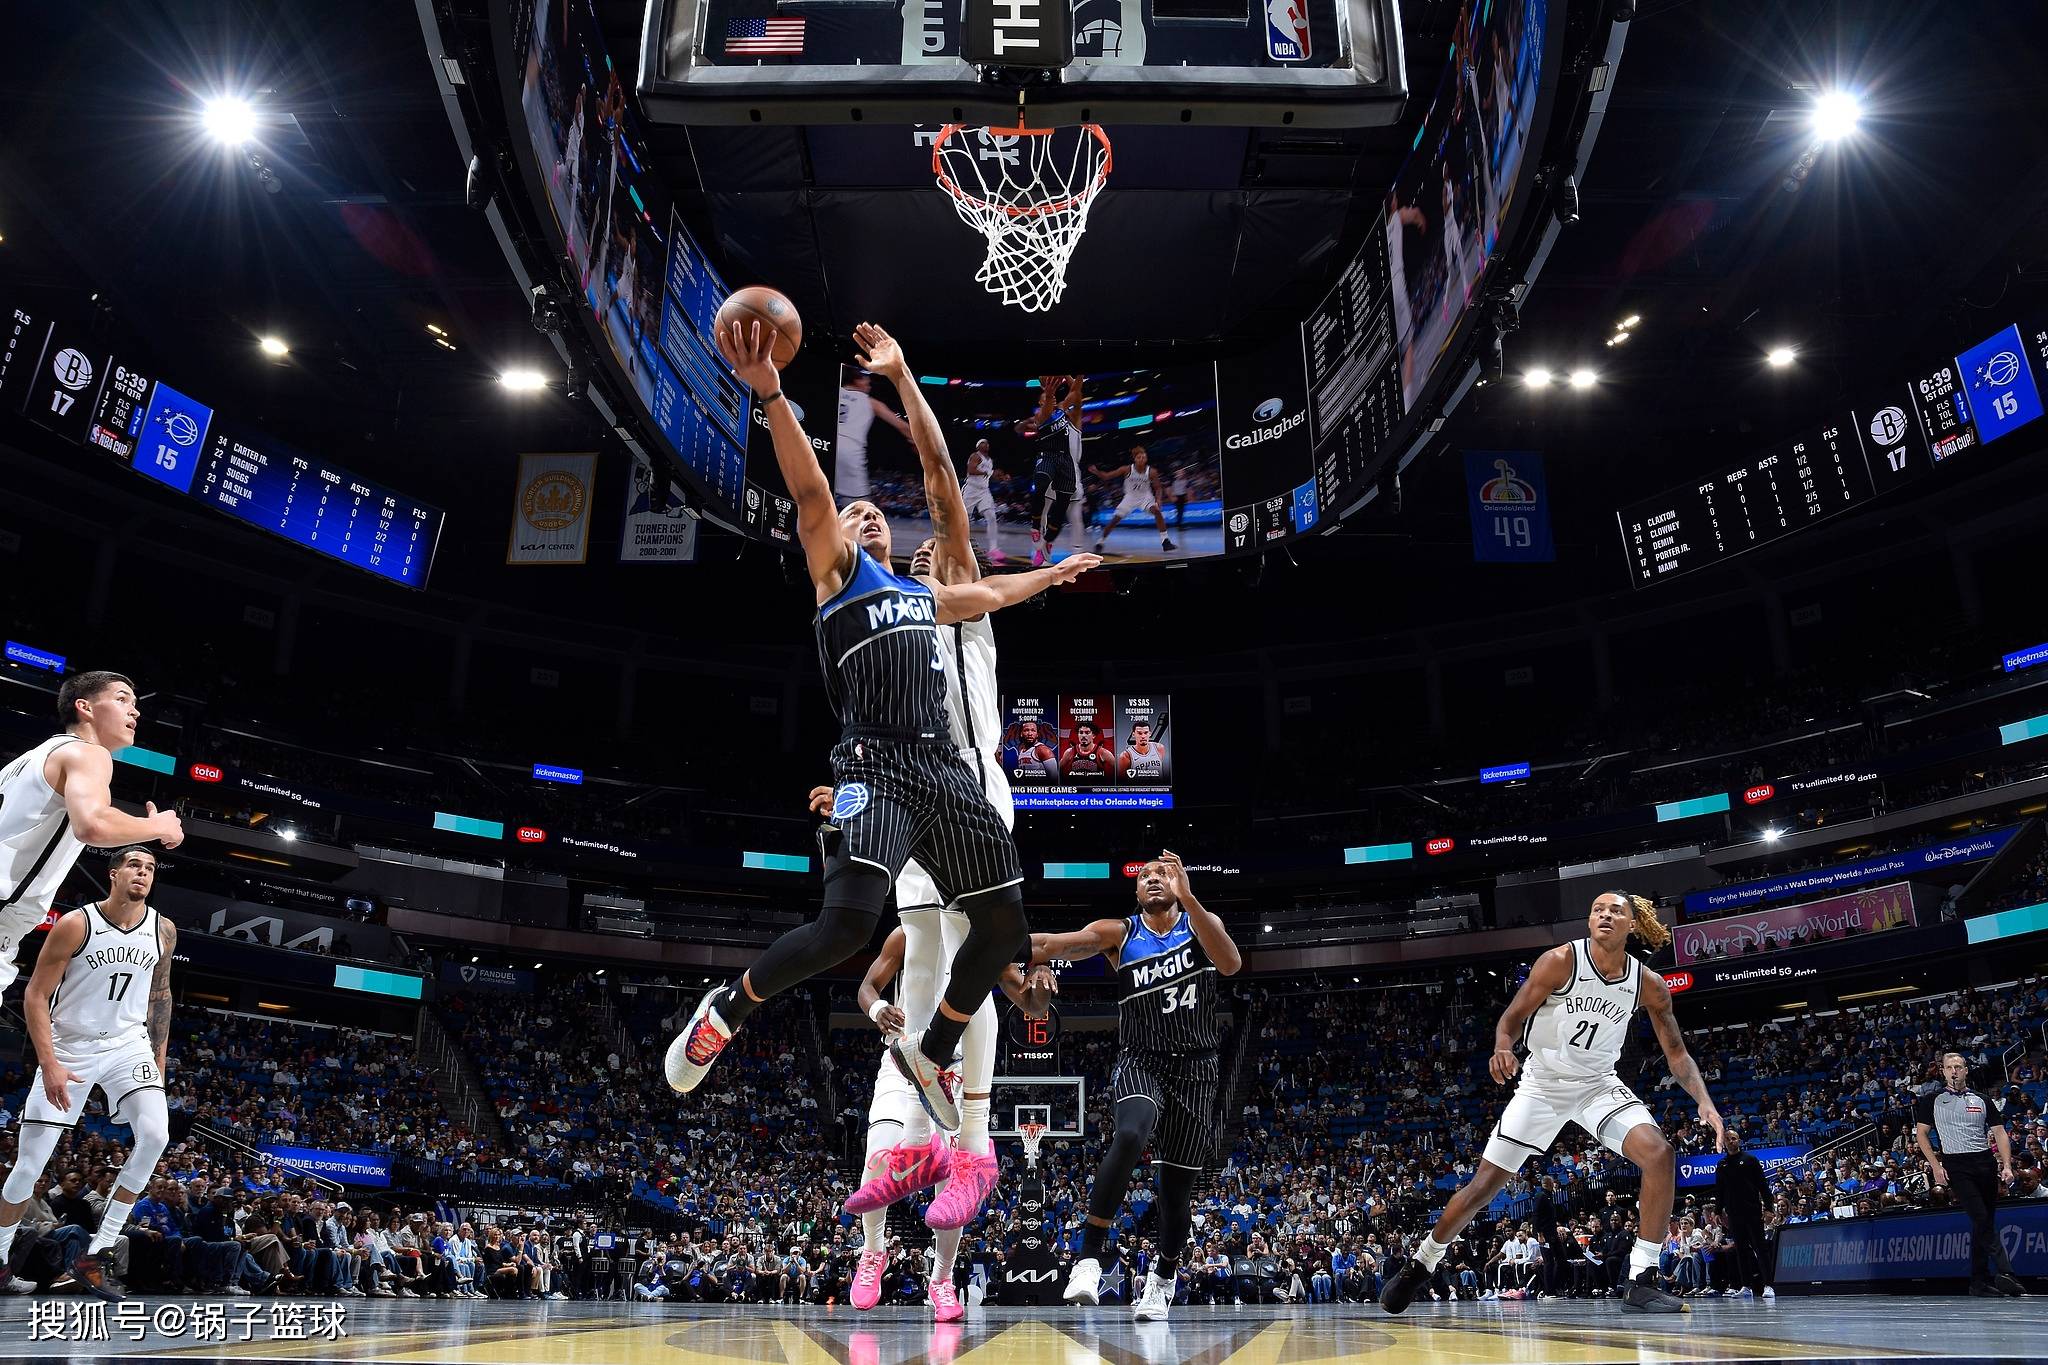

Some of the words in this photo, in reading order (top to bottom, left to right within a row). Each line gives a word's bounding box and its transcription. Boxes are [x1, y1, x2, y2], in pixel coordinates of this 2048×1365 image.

[1275, 43, 1295, 55] NBA
[14, 309, 31, 325] FLS
[116, 366, 147, 392] 6:39
[1920, 368, 1951, 394] 6:39
[115, 381, 127, 392] 1ST
[127, 388, 141, 400] QTR
[1925, 391, 1937, 402] 1ST
[1938, 383, 1953, 396] QTR
[51, 390, 74, 416] 17
[118, 399, 130, 410] FLS
[1936, 400, 1950, 411] FLS
[1993, 391, 2018, 420] 15
[112, 417, 124, 428] CHL
[115, 407, 126, 419] TOL
[1939, 410, 1952, 421] TOL
[1226, 409, 1306, 450] Gallagher
[1942, 418, 1956, 430] CHL
[99, 434, 113, 450] NBA
[113, 440, 128, 456] CUP
[218, 436, 228, 446] 34
[234, 443, 258, 461] CARTER
[258, 455, 268, 466] JR.
[1942, 442, 1957, 458] NBA
[1956, 434, 1971, 451] CUP
[154, 444, 178, 470] 15
[214, 448, 224, 458] 22
[230, 455, 258, 475] WAGNER
[1699, 483, 1714, 494] PTS
[1727, 469, 1748, 483] REBS
[1758, 456, 1778, 470] ASTS
[1794, 444, 1805, 454] FG
[1823, 428, 1838, 441] FLS
[1887, 446, 1906, 472] 17
[211, 461, 216, 469] 4
[226, 468, 249, 484] SUGGS
[203, 485, 208, 494] 3
[219, 492, 238, 507] BANE
[207, 473, 216, 483] 23
[223, 480, 232, 492] DA
[233, 484, 252, 500] SILVA
[293, 456, 308, 470] PTS
[320, 468, 341, 484] REBS
[350, 482, 370, 497] ASTS
[384, 496, 395, 507] FG
[412, 508, 427, 520] FLS
[775, 498, 792, 510] 6:39
[1267, 497, 1283, 509] 6:39
[748, 511, 756, 524] 17
[1304, 510, 1313, 524] 15
[1633, 524, 1641, 532] 33
[1648, 510, 1676, 527] CLAXTON
[635, 524, 668, 534] TURNER
[670, 524, 686, 533] CUP
[1494, 517, 1531, 547] 49
[1635, 535, 1642, 544] 21
[1650, 521, 1680, 538] CLOWNEY
[635, 535, 684, 544] CHAMPIONS
[1235, 535, 1245, 547] 17
[1638, 547, 1643, 555] 8
[1653, 536, 1674, 550] DEMIN
[640, 548, 676, 556] 2000-2001
[1640, 559, 1647, 567] 17
[1656, 546, 1680, 561] PORTER
[1680, 544, 1690, 553] JR.
[1643, 570, 1650, 578] 14
[1658, 560, 1678, 573] MANN
[8, 647, 62, 668] ticketmaster
[195, 767, 219, 779] total
[536, 768, 580, 781] ticketmaster
[1483, 767, 1527, 779] ticketmaster
[1792, 782, 1804, 790] It's
[1806, 774, 1843, 788] unlimited
[1858, 774, 1877, 782] data
[241, 779, 253, 787] It's
[254, 783, 290, 796] unlimited
[291, 793, 302, 801] 5G
[302, 799, 320, 808] data
[1030, 798, 1078, 806] Marketplace
[1139, 798, 1163, 806] Magic
[1747, 786, 1770, 799] total
[521, 830, 543, 839] total
[1483, 835, 1517, 845] unlimited
[575, 839, 608, 850] unlimited
[620, 850, 637, 858] data
[1429, 840, 1450, 850] total
[1709, 893, 1726, 904] Enjoy
[1727, 892, 1738, 900] the
[1738, 887, 1767, 898] Holidays
[1768, 884, 1783, 892] with
[1789, 880, 1807, 888] Walt
[1808, 874, 1834, 887] Disney
[1863, 865, 1888, 875] Annual
[1889, 860, 1905, 870] Pass
[310, 892, 335, 901] inspires
[1807, 908, 1862, 934] World
[86, 946, 156, 971] BROOKLYN
[1132, 948, 1194, 988] MAGIC
[480, 969, 516, 980] FANDUEL
[1715, 973, 1730, 981] It's
[1732, 966, 1777, 980] unlimited
[1779, 967, 1792, 976] 5G
[108, 972, 133, 1002] 17
[1162, 984, 1197, 1014] 34
[1565, 996, 1627, 1024] BROOKLYN
[1028, 1022, 1046, 1044] 16
[1569, 1020, 1599, 1051] 21
[275, 1156, 314, 1169] FANDUEL
[315, 1161, 346, 1172] SPORTS
[347, 1165, 386, 1176] NETWORK
[1781, 1244, 1812, 1268] WATCH
[1814, 1243, 1830, 1266] THE
[1832, 1241, 1864, 1264] MAGIC
[1866, 1238, 1884, 1263] ALL
[1887, 1235, 1934, 1262] SEASON
[1936, 1232, 1970, 1260] LONG
